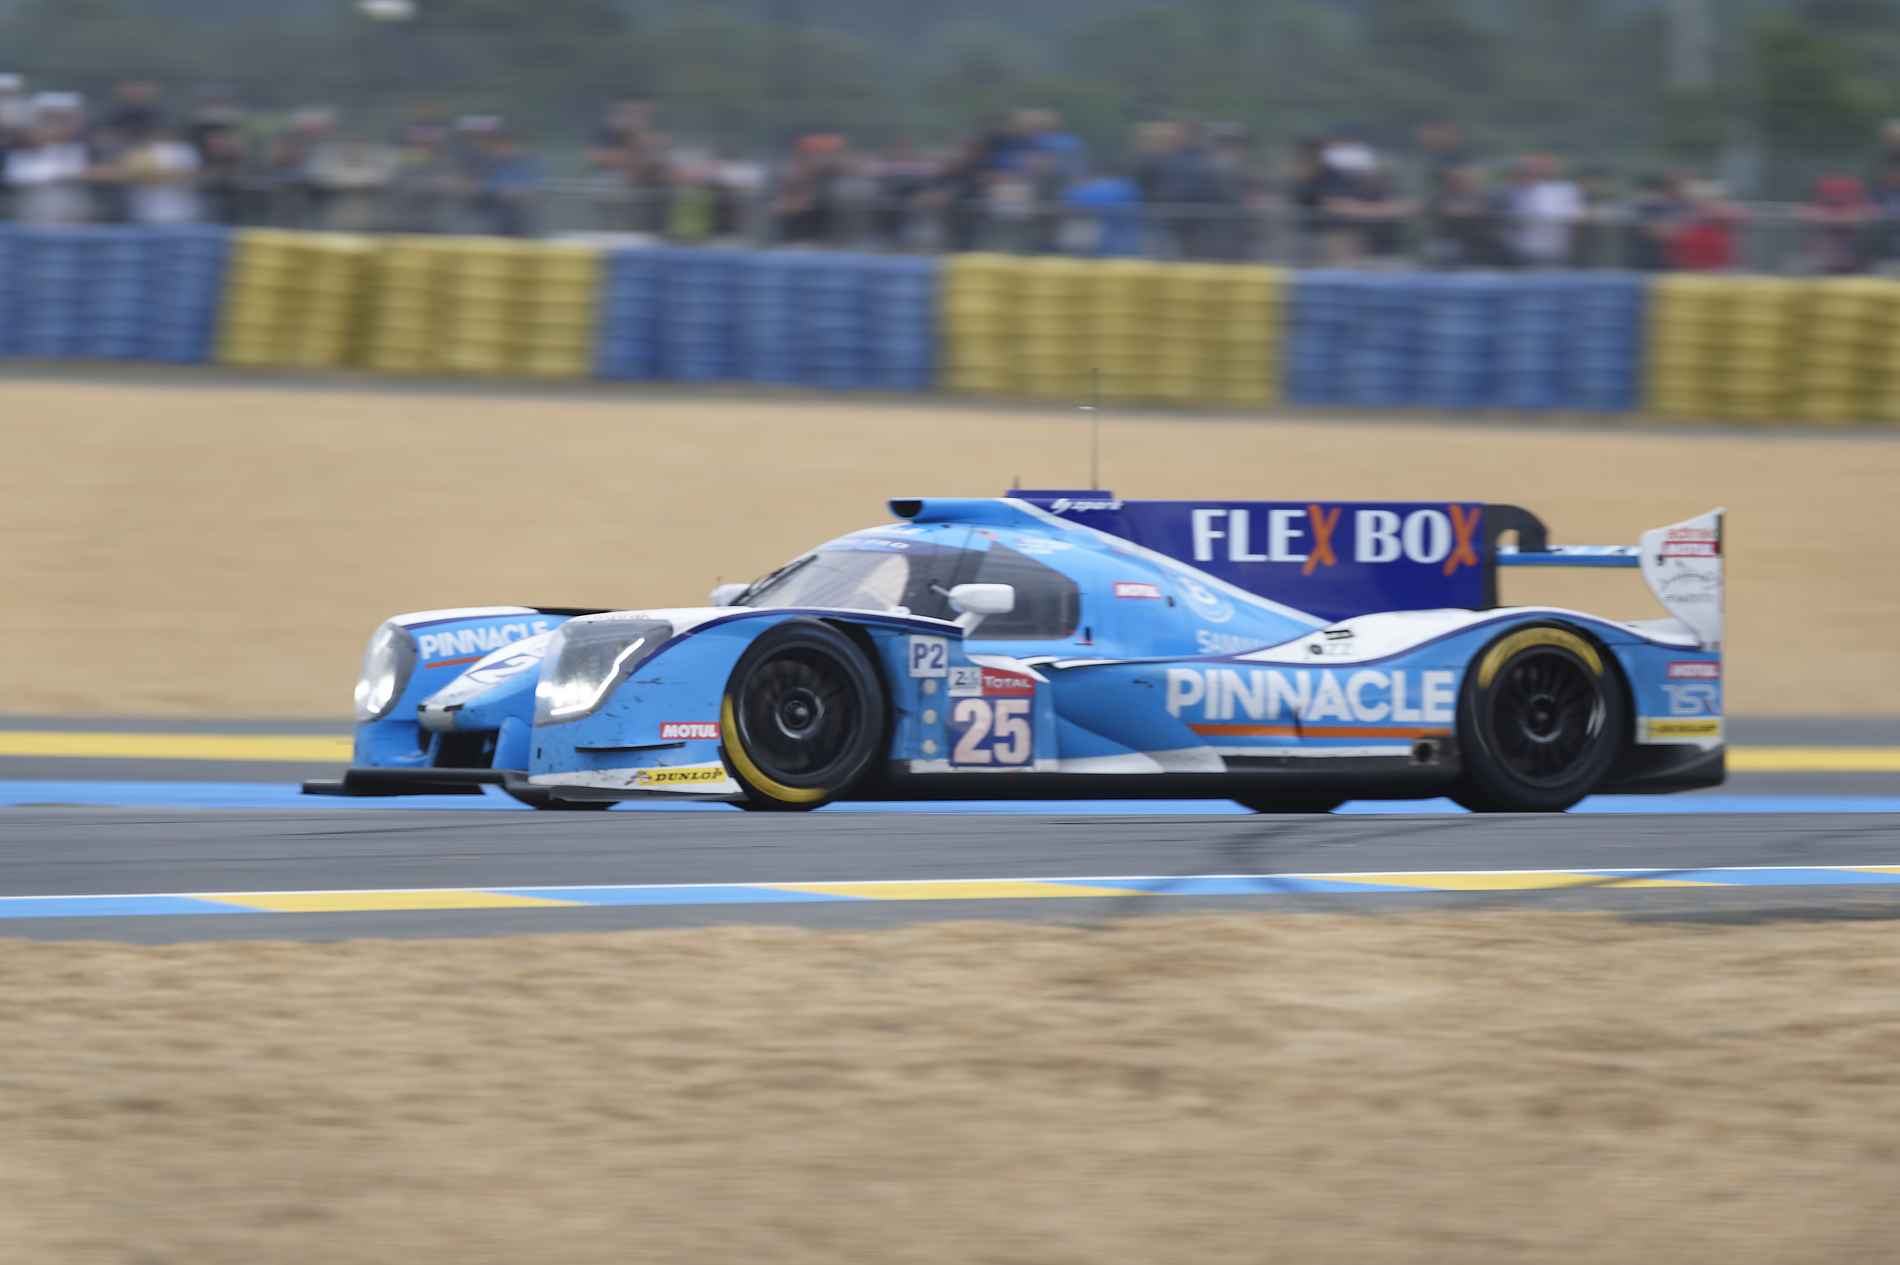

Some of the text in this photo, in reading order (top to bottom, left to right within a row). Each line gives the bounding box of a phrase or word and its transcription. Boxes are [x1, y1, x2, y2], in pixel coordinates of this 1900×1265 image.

[1192, 504, 1482, 576] FLEX BOX
[913, 642, 945, 670] P2
[1166, 668, 1456, 723] PINNACLE
[662, 724, 718, 738] MOTUL
[953, 698, 1031, 764] 25
[656, 768, 722, 782] DUNLOP
